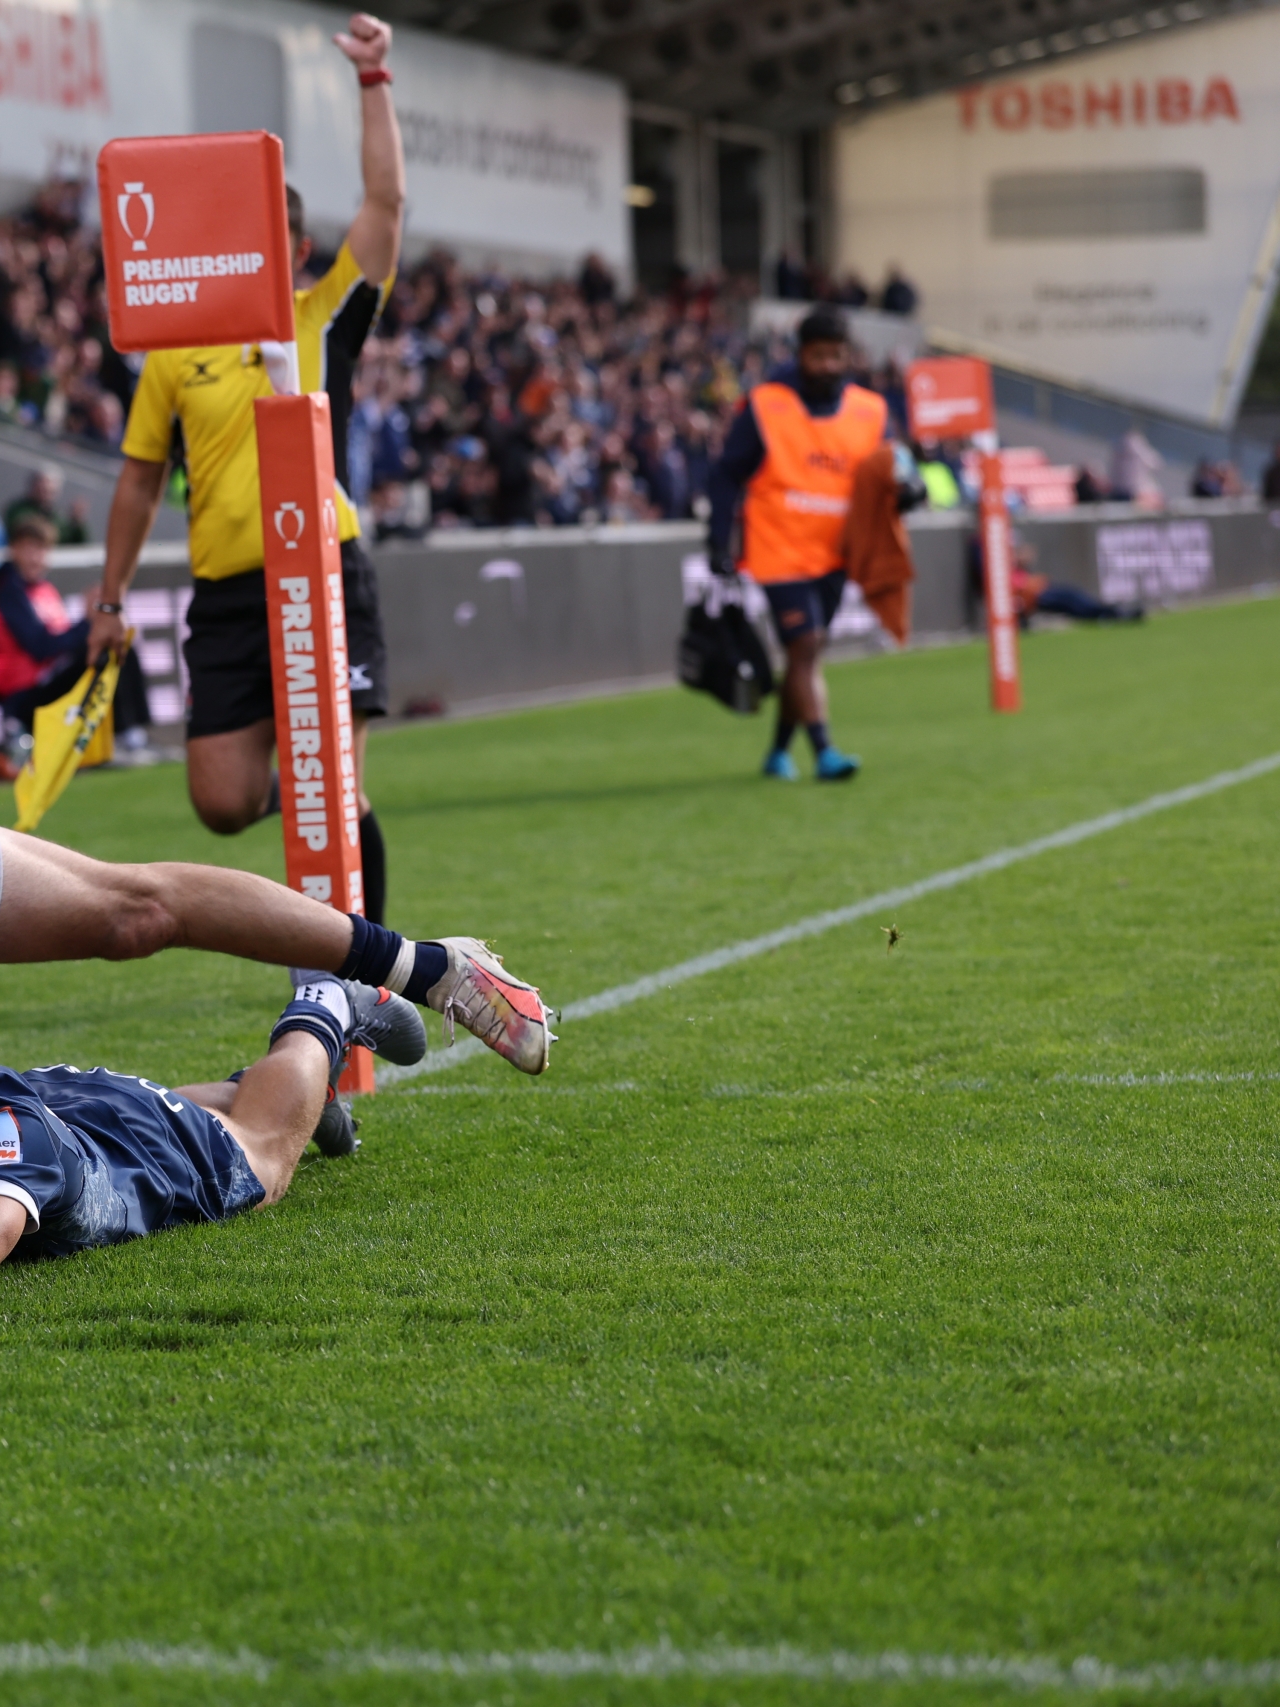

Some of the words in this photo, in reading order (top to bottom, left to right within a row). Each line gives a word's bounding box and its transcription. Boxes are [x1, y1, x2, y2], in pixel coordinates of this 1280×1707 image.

[953, 76, 1242, 134] TOSHIBA
[123, 252, 264, 282] PREMIERSHIP
[125, 281, 199, 306] RUGBY
[279, 577, 328, 852] PREMIERSHIP
[327, 572, 359, 847] PREMIERSHIP
